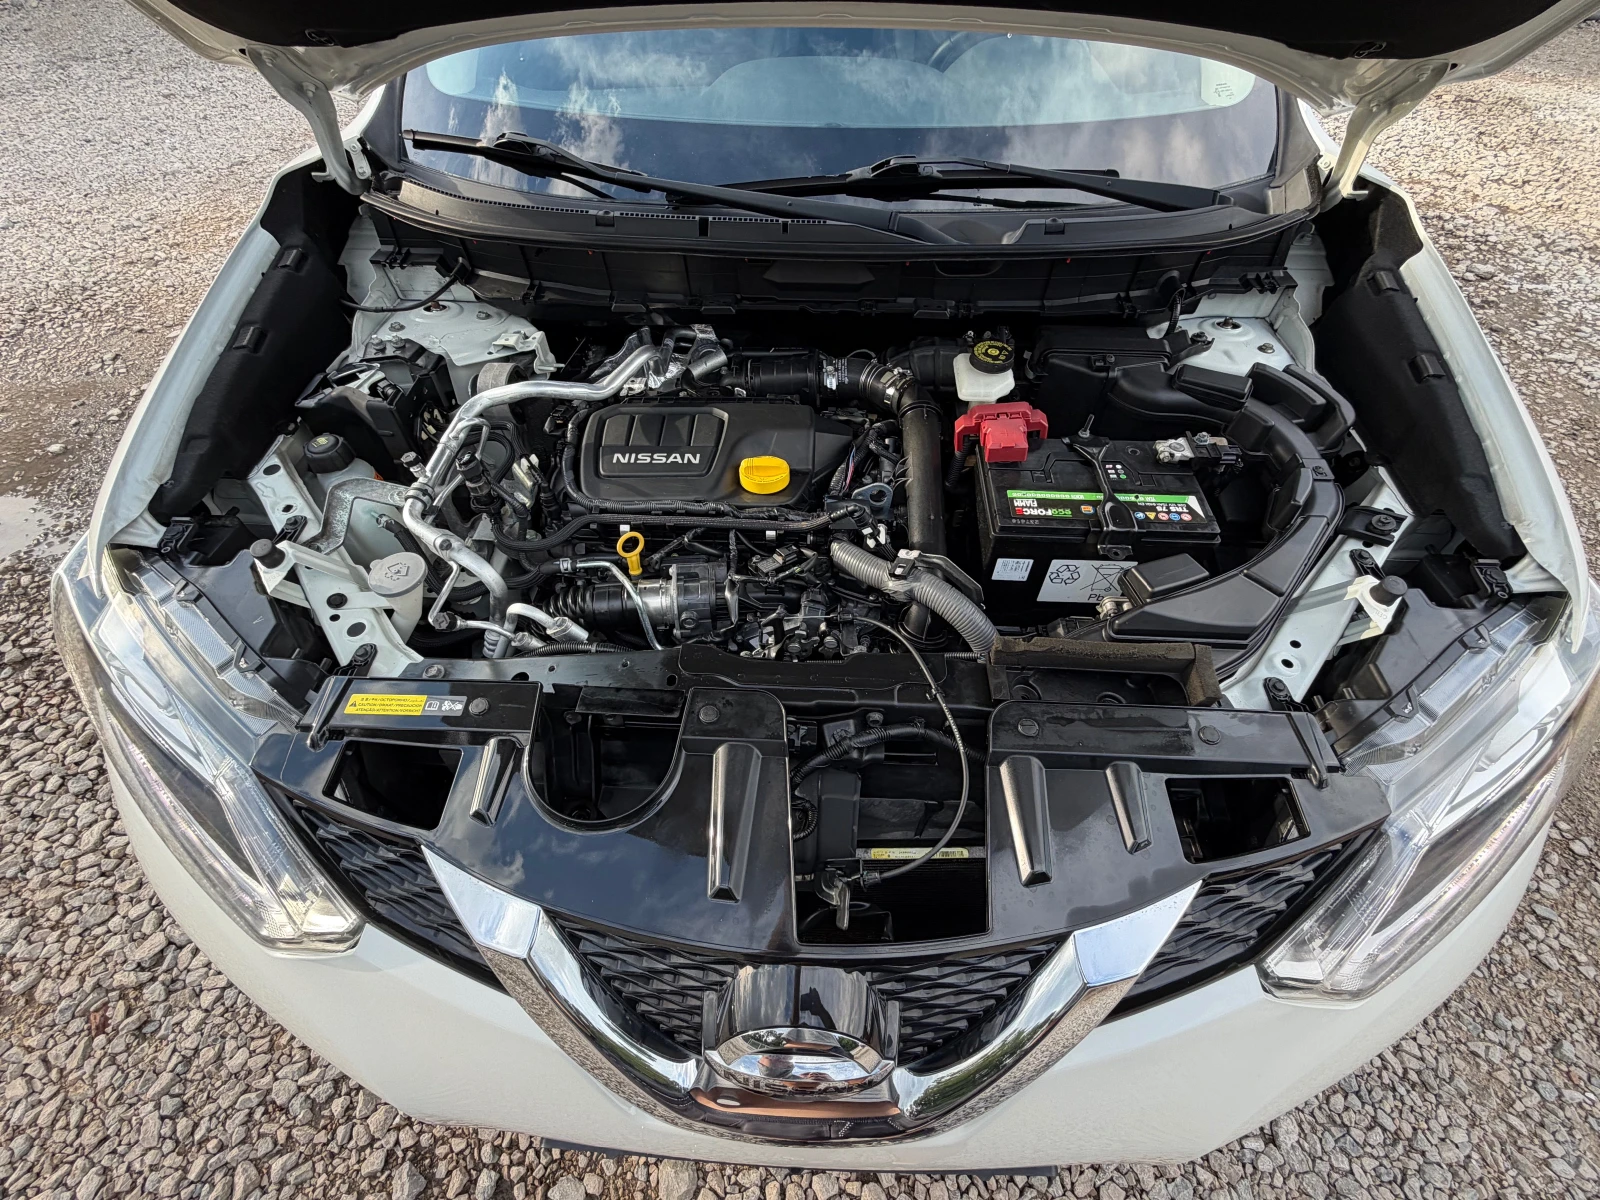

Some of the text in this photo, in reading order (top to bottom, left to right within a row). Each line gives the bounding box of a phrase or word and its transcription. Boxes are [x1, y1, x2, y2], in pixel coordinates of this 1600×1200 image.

[612, 453, 700, 464] NISSAN
[1013, 499, 1038, 507] FIAMM
[1015, 507, 1072, 517] ecoFORCE
